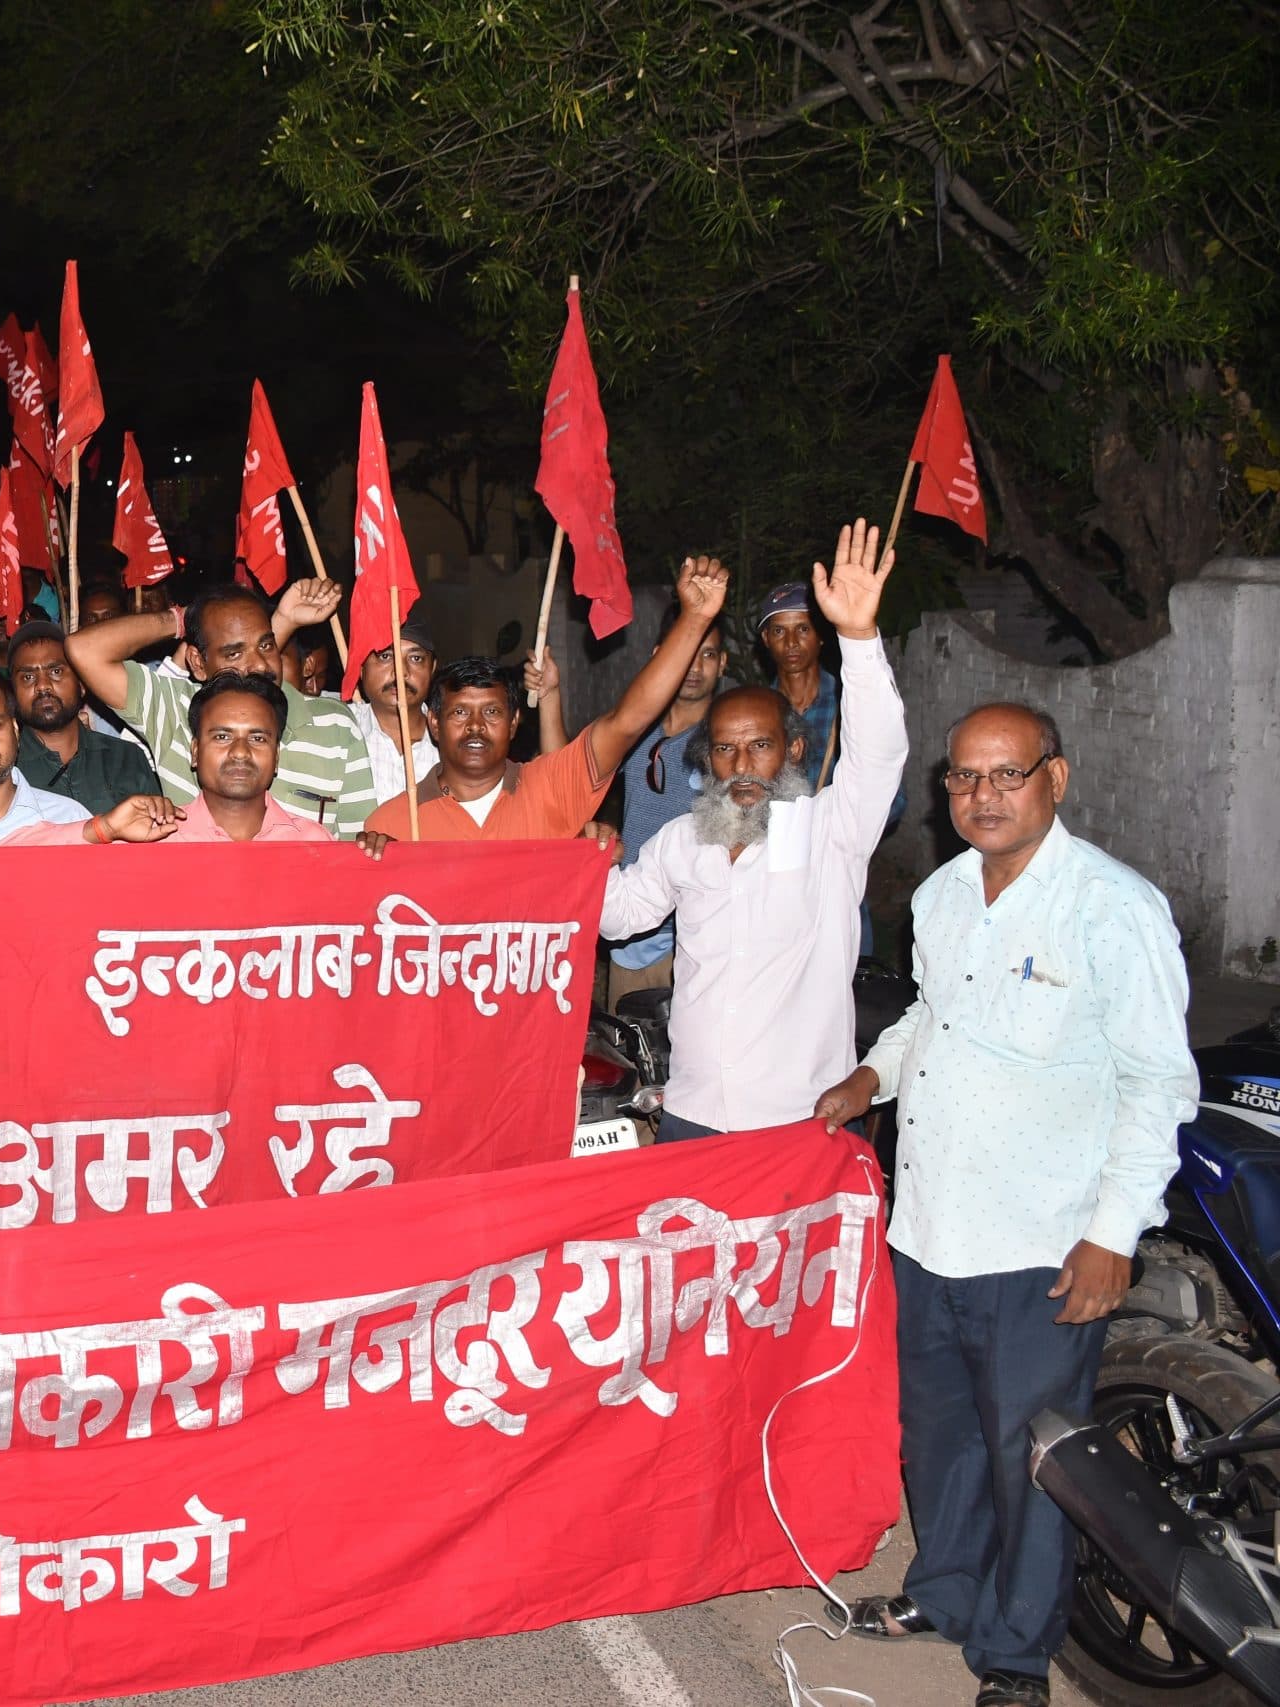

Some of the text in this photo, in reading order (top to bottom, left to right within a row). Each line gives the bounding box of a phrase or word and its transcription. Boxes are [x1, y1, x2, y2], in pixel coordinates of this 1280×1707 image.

[271, 1063, 422, 1198] रहे
[275, 1251, 552, 1437] मजदूर
[554, 1196, 880, 1418] यूनियन
